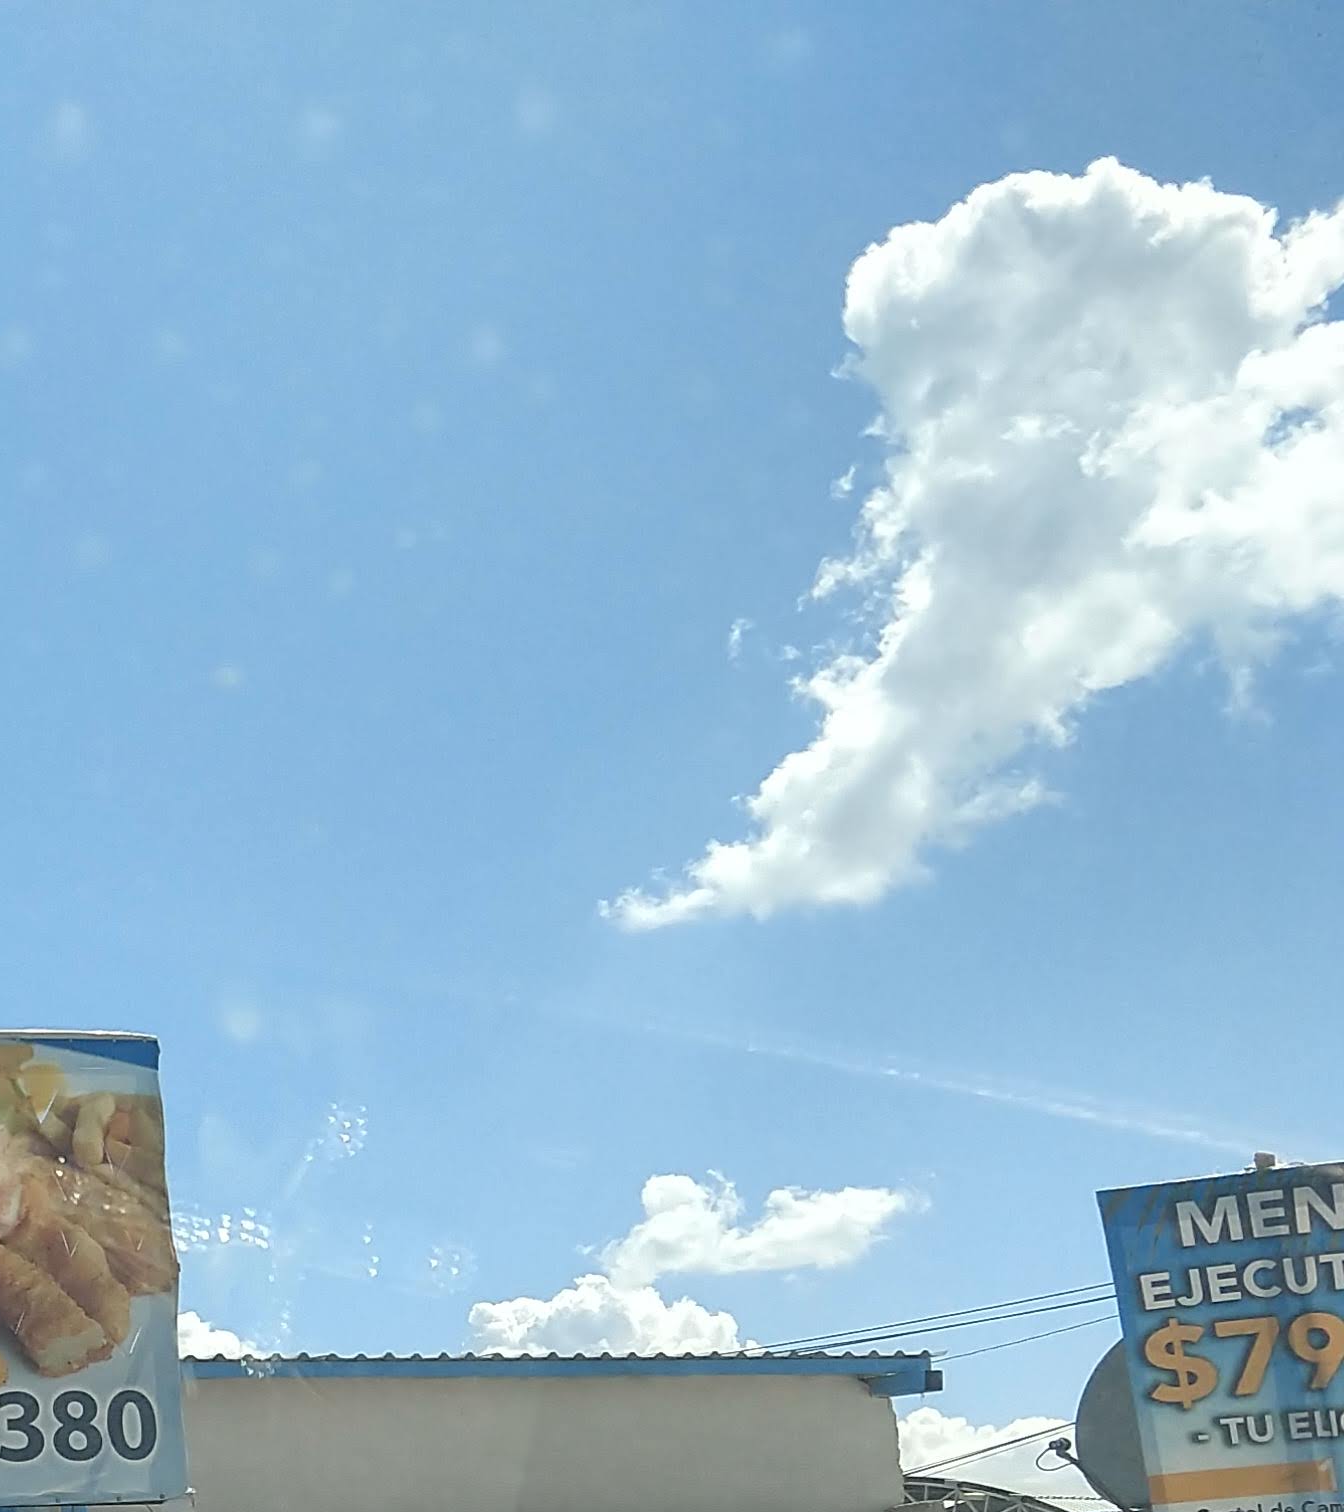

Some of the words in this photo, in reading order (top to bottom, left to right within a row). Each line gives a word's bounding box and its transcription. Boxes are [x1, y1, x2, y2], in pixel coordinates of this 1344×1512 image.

[1176, 1183, 1344, 1247] MEN
[1145, 1312, 1344, 1409] $79
[1220, 1414, 1273, 1445] TU
[1288, 1409, 1344, 1440] ELI
